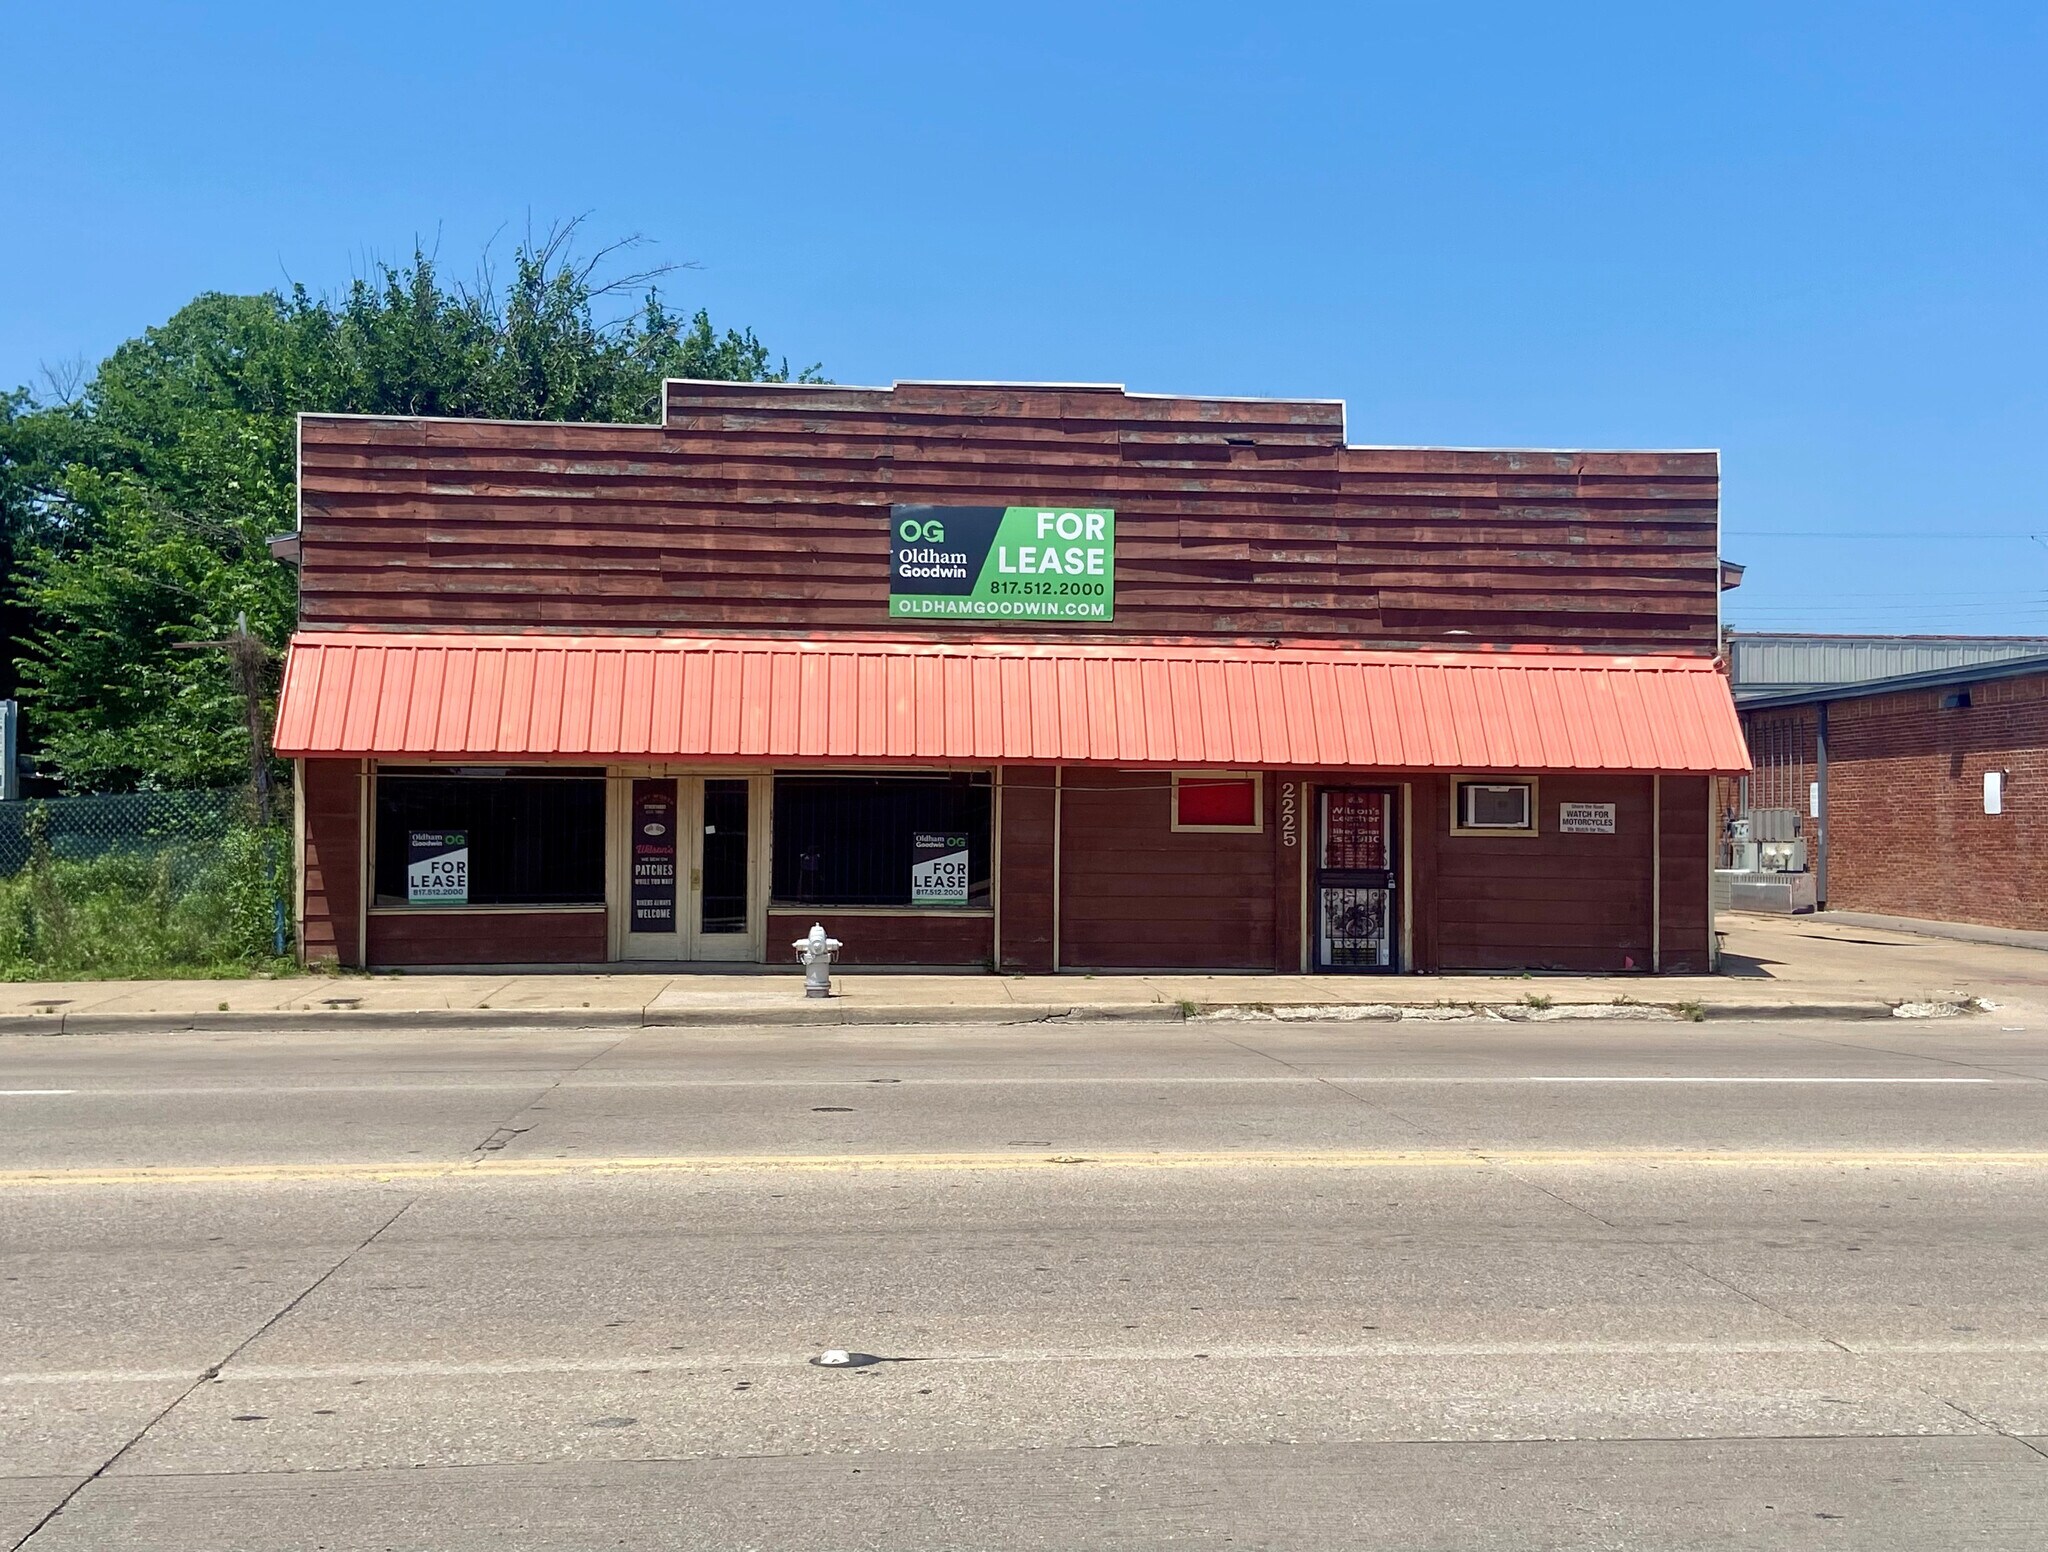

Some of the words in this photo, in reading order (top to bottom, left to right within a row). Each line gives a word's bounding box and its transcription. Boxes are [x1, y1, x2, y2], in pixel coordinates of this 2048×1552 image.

[900, 520, 944, 543] OG
[1037, 512, 1105, 541] FOR
[900, 549, 967, 565] Oldham
[999, 546, 1104, 575] LEASE
[900, 564, 966, 578] Goodwin
[990, 581, 1104, 596] 817.512.2000
[900, 600, 1104, 616] OLDHAMGOODWIN.COM
[1282, 782, 1297, 847] 2225
[1566, 810, 1592, 818] WATCH
[1562, 818, 1613, 827] MOTORCYCLES
[445, 835, 465, 845] OG
[946, 837, 966, 847] OG
[431, 861, 466, 874] FOR
[635, 864, 673, 876] PATCHES
[933, 863, 966, 875] FOR
[410, 875, 466, 888] LEASE
[914, 876, 966, 888] LEASE
[413, 888, 464, 896] 817.512.2000
[637, 908, 671, 919] WELCOME
